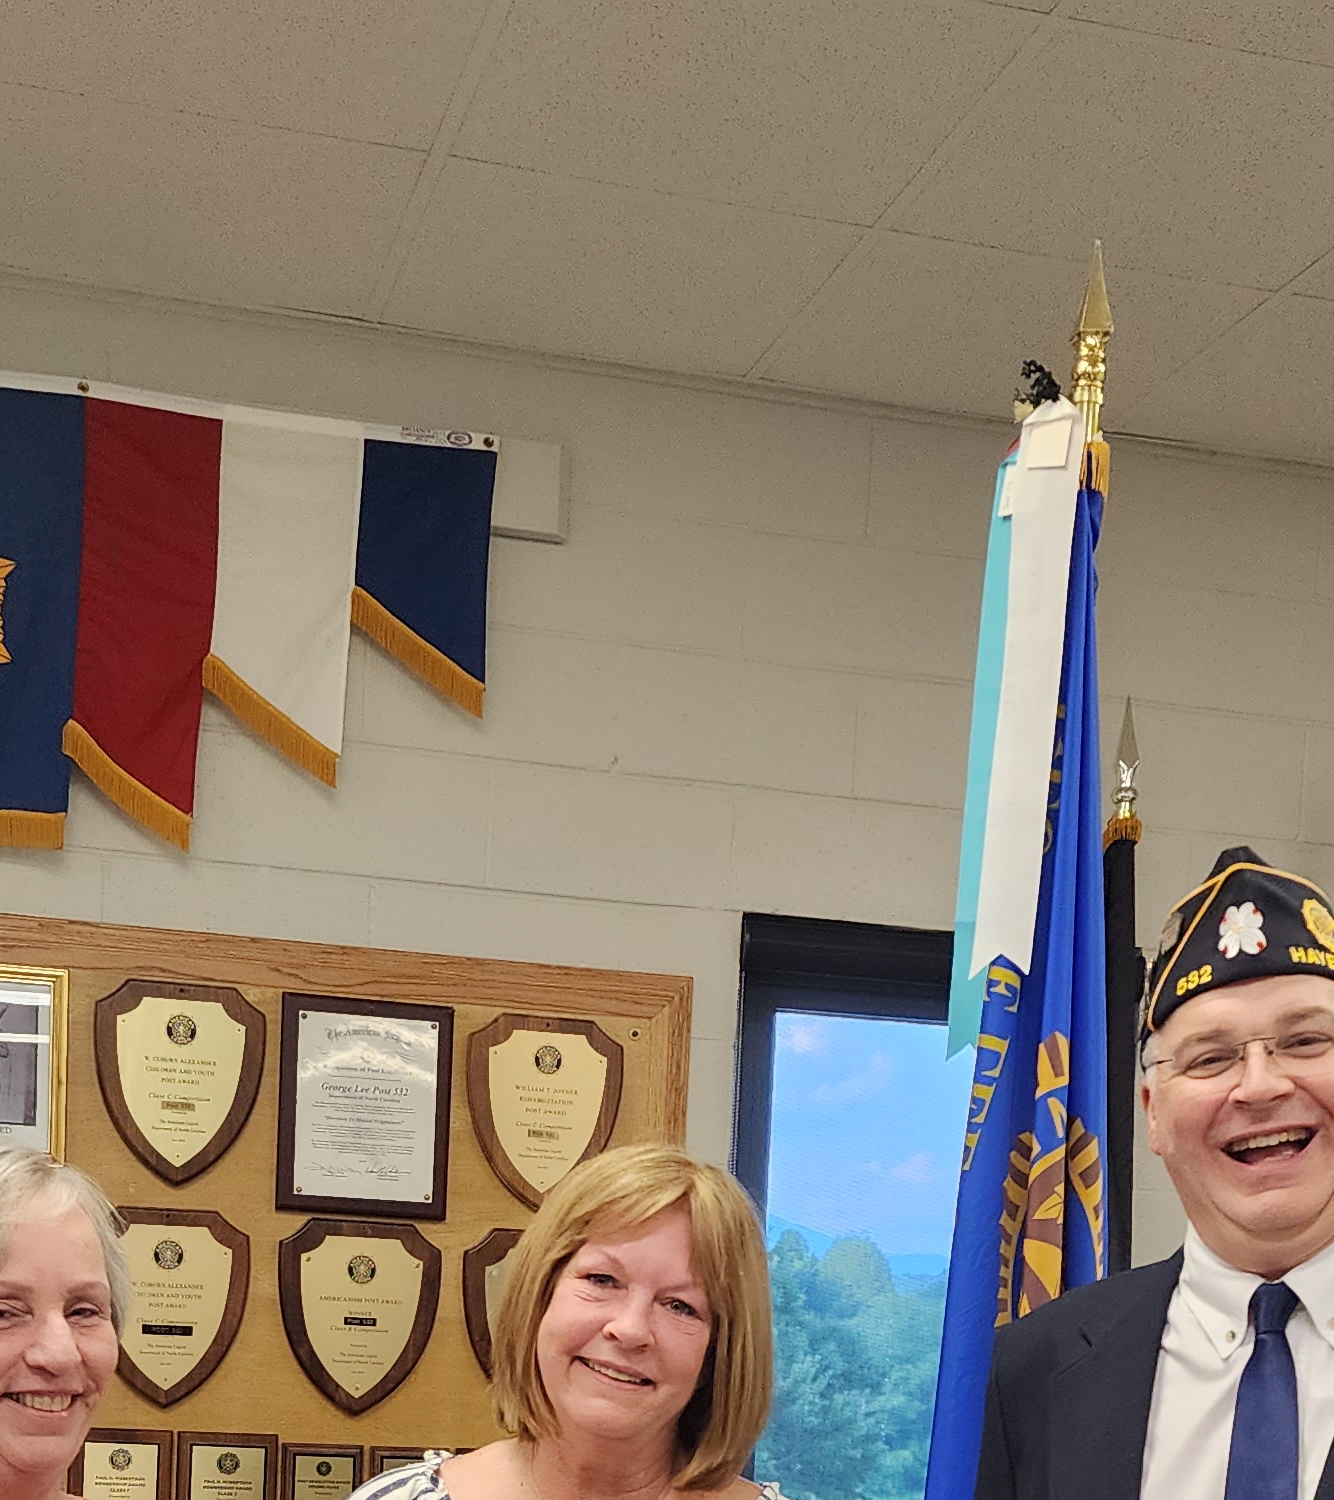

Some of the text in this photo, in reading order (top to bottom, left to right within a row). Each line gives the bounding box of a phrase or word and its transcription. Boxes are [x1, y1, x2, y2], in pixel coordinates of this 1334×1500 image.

[1175, 964, 1213, 997] 532
[321, 1082, 409, 1097] George Lee Post 532
